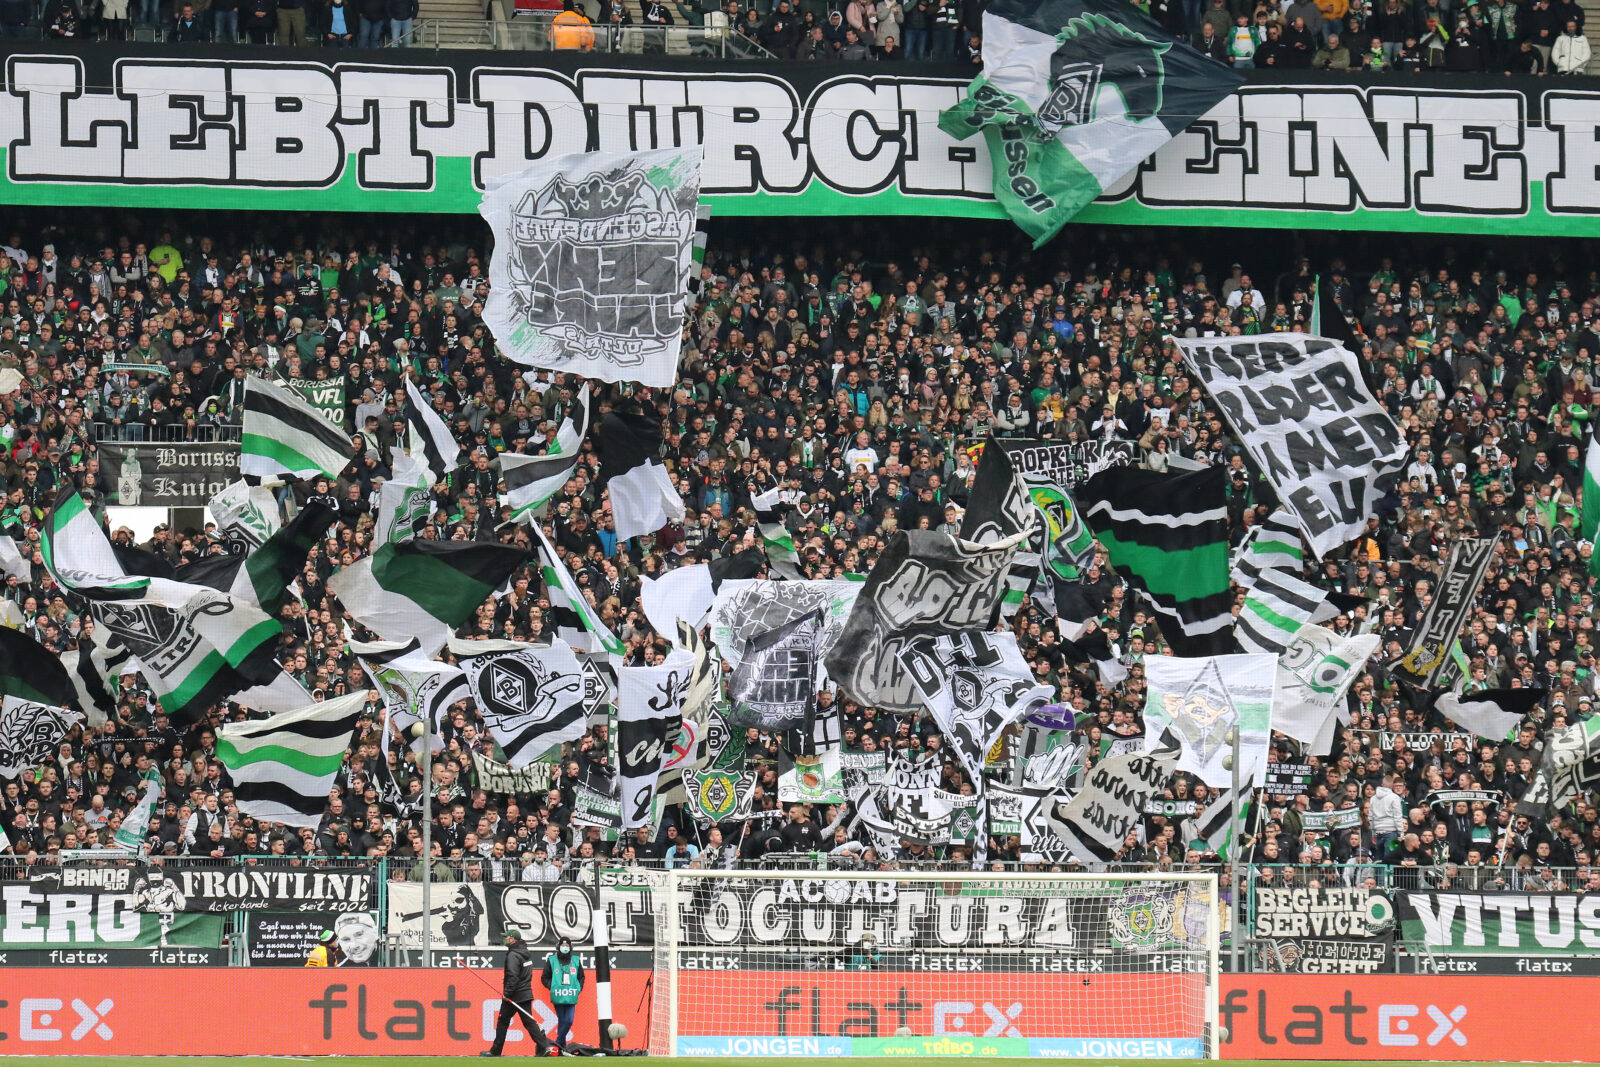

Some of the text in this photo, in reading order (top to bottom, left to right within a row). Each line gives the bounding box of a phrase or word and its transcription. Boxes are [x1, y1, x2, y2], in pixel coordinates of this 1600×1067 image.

[6, 54, 456, 190] LEBT
[1098, 85, 1529, 218] EINE
[289, 376, 344, 388] BORUSSIA
[313, 388, 342, 404] VFL
[64, 868, 130, 886] BANDA
[180, 871, 370, 901] FRONTLINE
[299, 901, 325, 911] seit
[329, 902, 368, 911] 2006
[1256, 888, 1369, 912] BEGLEIT
[501, 883, 1077, 949] SOTTOCULTURA
[1256, 912, 1366, 936] SERVICE
[1301, 940, 1385, 963] HEUTE
[1302, 958, 1378, 974] GEHT
[555, 988, 577, 997] HOST
[721, 1038, 819, 1056] JONGEN
[1076, 1041, 1173, 1057] JONGEN
